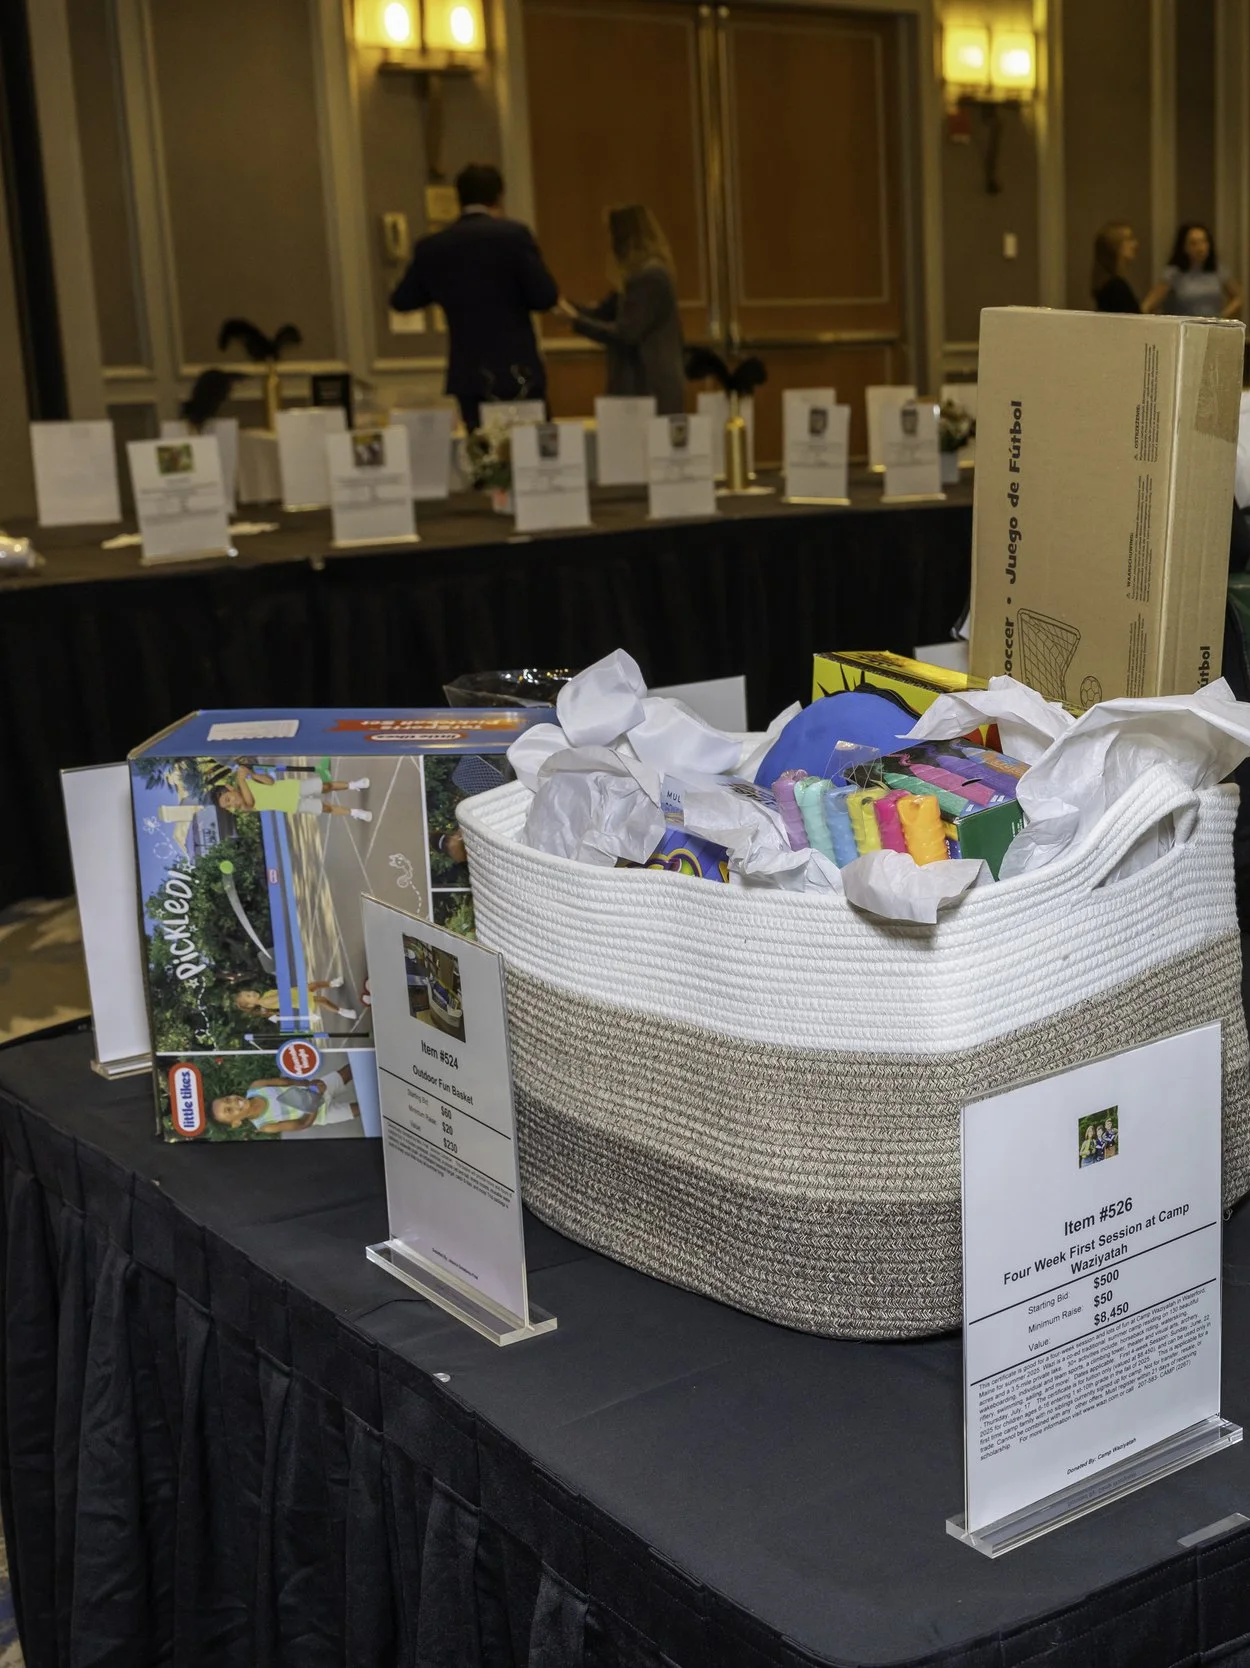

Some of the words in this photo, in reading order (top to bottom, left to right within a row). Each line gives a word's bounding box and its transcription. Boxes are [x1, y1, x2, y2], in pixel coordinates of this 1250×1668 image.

[1008, 400, 1023, 473] Fútbol
[1007, 482, 1020, 507] de
[1005, 516, 1022, 584] Juego
[1199, 646, 1211, 687] útbol
[666, 790, 680, 803] MUL
[421, 1040, 438, 1059] Item
[439, 1050, 458, 1069] #524
[180, 1071, 193, 1099] tikes
[412, 1064, 437, 1085] Outdoor
[438, 1078, 450, 1092] Fun
[451, 1085, 473, 1105] Basket
[181, 1101, 195, 1128] little
[441, 1105, 452, 1119] $60
[442, 1121, 453, 1135] $20
[443, 1137, 457, 1153] $230
[1064, 1215, 1095, 1236] Item
[1099, 1197, 1132, 1222] #526
[1004, 1266, 1031, 1285] Four
[1034, 1251, 1066, 1272] Week
[1070, 1239, 1095, 1258] First
[1098, 1222, 1142, 1246] Session
[1145, 1215, 1155, 1228] at
[1158, 1204, 1189, 1222] Camp
[1070, 1243, 1127, 1274] Waziyatah
[1028, 1298, 1055, 1314] Starting
[1057, 1292, 1071, 1302] Bid:
[1093, 1269, 1119, 1289] $500
[1028, 1315, 1060, 1333] Minimum
[1062, 1306, 1084, 1319] Raise:
[1093, 1290, 1113, 1308] $50
[1028, 1339, 1051, 1351] Value:
[1094, 1301, 1129, 1326] $8,450
[1067, 1460, 1088, 1475] Donated
[1097, 1450, 1112, 1460] Camp
